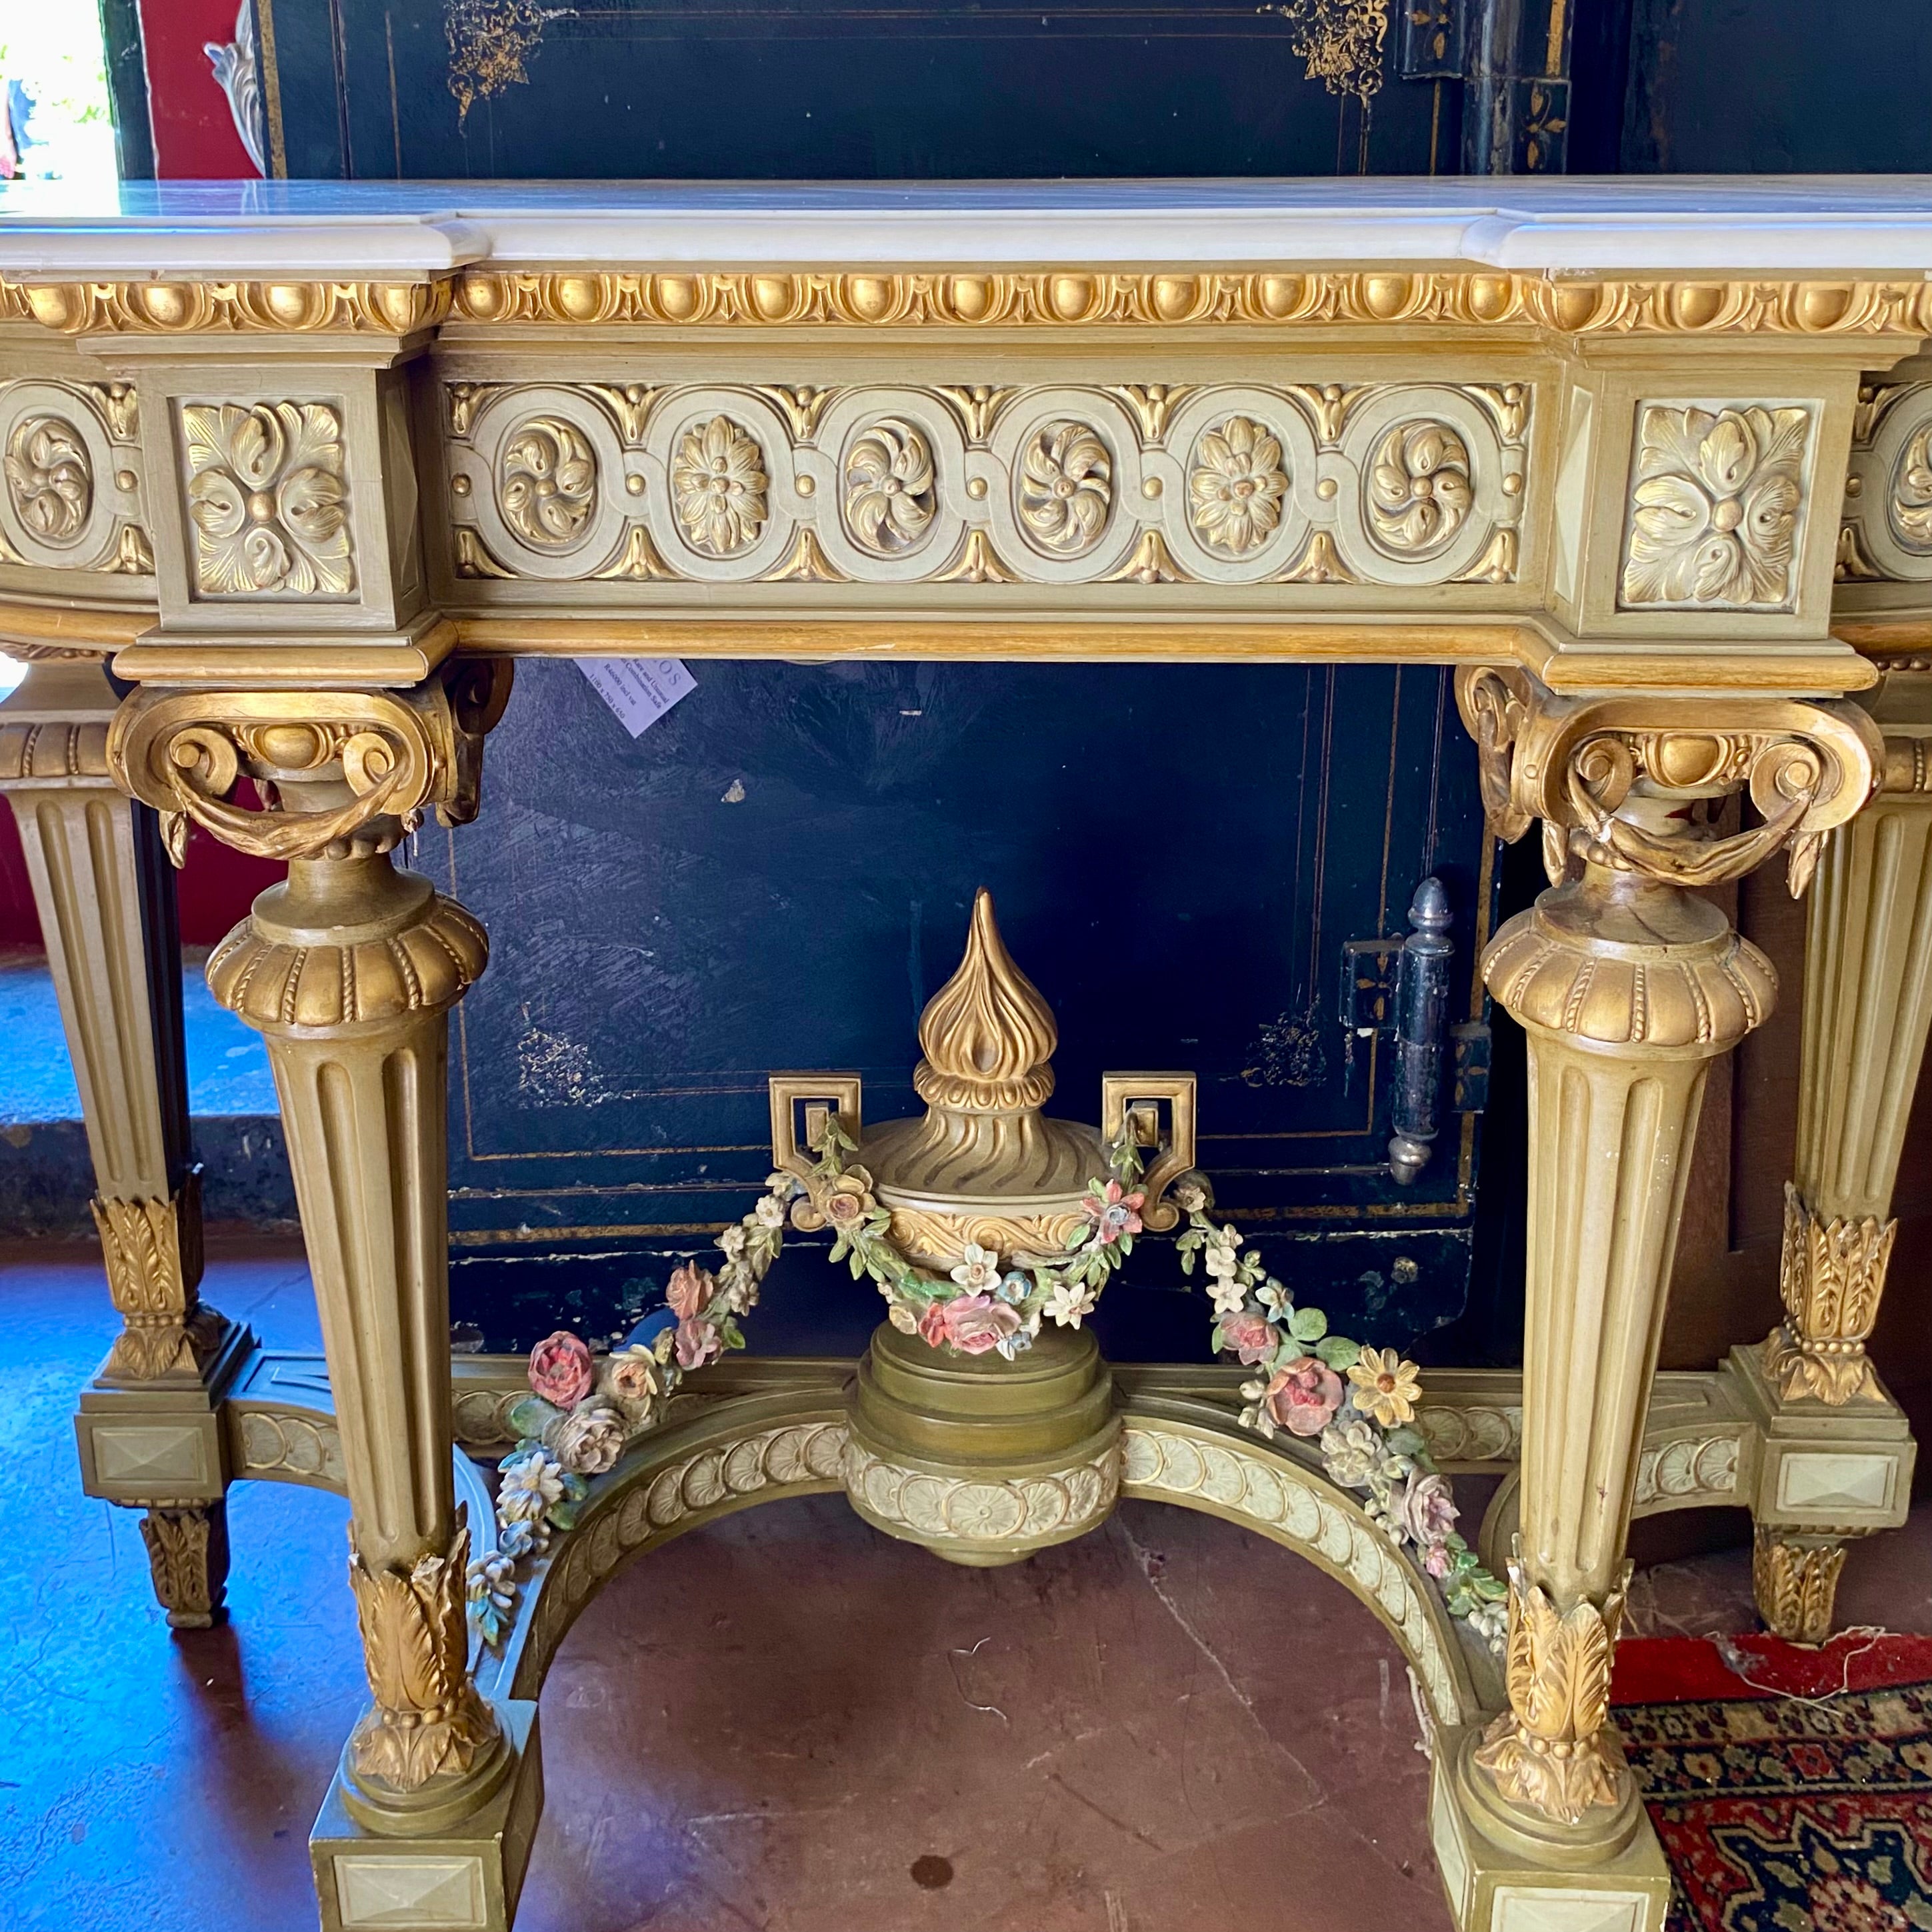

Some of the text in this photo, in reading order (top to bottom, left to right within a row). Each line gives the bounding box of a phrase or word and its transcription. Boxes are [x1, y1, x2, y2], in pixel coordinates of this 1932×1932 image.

[619, 684, 631, 697] incl
[629, 695, 637, 705] vat
[625, 663, 661, 709] Combination Safe
[643, 671, 653, 682] and
[651, 680, 670, 703] Unusual
